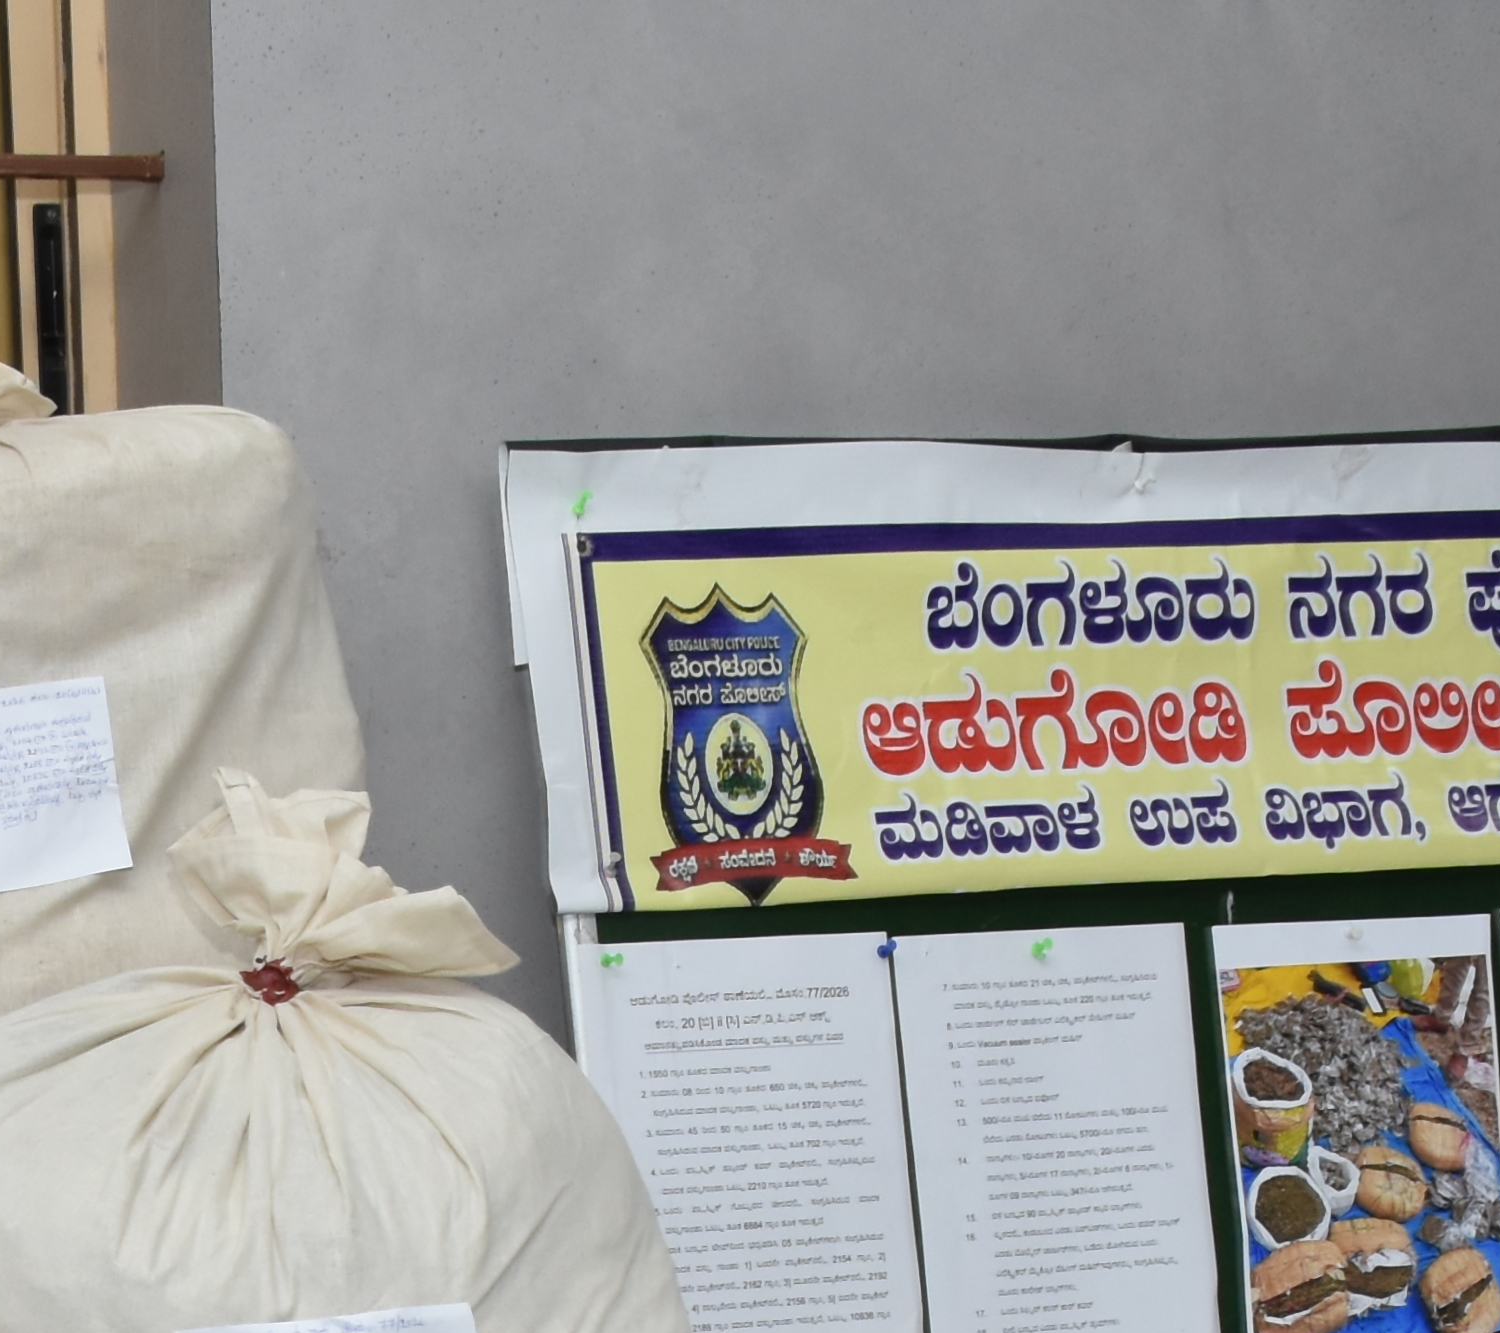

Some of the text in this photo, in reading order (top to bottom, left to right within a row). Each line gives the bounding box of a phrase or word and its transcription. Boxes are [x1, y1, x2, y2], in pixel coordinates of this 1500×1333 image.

[926, 558, 1255, 650] ಬೆಂಗಳೂರು
[1287, 551, 1434, 640] ನಗರ
[668, 636, 780, 651] BENGALURU CITY POLICE
[670, 653, 782, 678] ಬೆಂಗಳೂರು
[673, 682, 786, 705] ನಗರ ಪೊಲೀಸ್
[862, 668, 1248, 776] ಆಡುಗೋಡಿ
[874, 784, 1101, 861] ಮಡಿವಾಳ
[1129, 777, 1238, 847] ಉಪ
[1263, 771, 1427, 850] ವಿಭಾಗ,
[681, 1018, 695, 1029] 20
